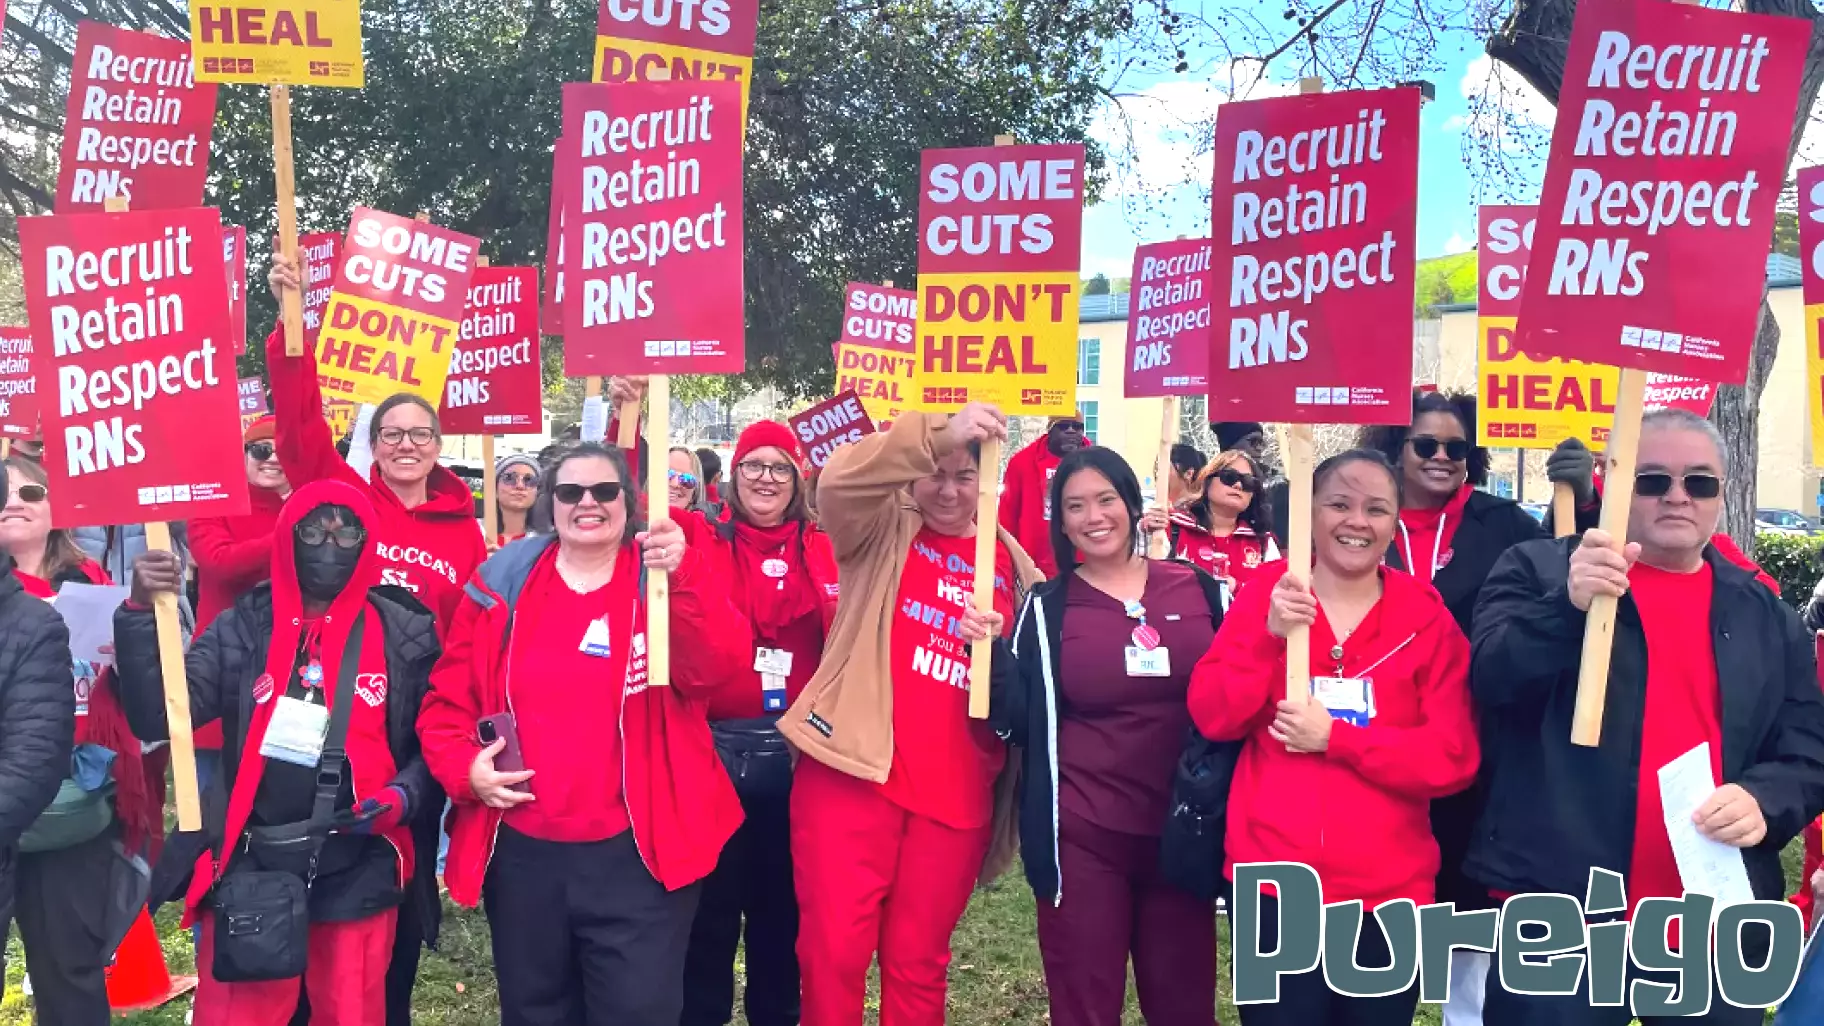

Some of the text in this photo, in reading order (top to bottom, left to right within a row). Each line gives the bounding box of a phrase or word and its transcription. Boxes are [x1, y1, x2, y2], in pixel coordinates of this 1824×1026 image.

[199, 7, 333, 48] HEAL
[608, 0, 731, 36] CUTS
[87, 44, 194, 89] Recruit
[1588, 30, 1770, 92] Recruit
[82, 85, 182, 125] Retain
[580, 95, 714, 158] Recruit
[76, 127, 198, 169] Respect
[1231, 107, 1386, 184] Recruit
[1573, 98, 1737, 156] Retain
[71, 168, 134, 203] RNs
[581, 150, 700, 214] Retain
[927, 159, 1075, 204] SOME
[1561, 168, 1759, 234] Respect
[1231, 173, 1367, 246] Retain
[303, 238, 335, 262] ecruit
[354, 218, 472, 273] SOME
[581, 201, 726, 270] Respect
[926, 213, 1054, 256] CUTS
[46, 226, 193, 297] Recruit
[309, 261, 332, 284] tain
[344, 254, 447, 303] CUTS
[1140, 246, 1212, 282] Recruit
[1229, 230, 1396, 307] Respect
[1547, 237, 1649, 297] RNs
[464, 276, 523, 309] ecruit
[582, 271, 655, 328] RNs
[924, 283, 1071, 323] DON'T
[1138, 276, 1202, 311] Retain
[51, 287, 184, 357] Retain
[330, 301, 451, 354] DON'T
[456, 307, 516, 342] etain
[846, 315, 913, 343] CUTS
[1135, 303, 1211, 342] Respect
[1228, 310, 1309, 370] RNs
[0, 334, 33, 354] ecrui
[0, 354, 29, 375] etain
[320, 337, 422, 387] HEAL
[448, 337, 531, 374] Respect
[842, 349, 917, 378] DON'T
[923, 334, 1047, 374] HEAL
[1133, 340, 1172, 372] RNs
[0, 375, 36, 398] espect
[58, 338, 219, 418] Respect
[447, 376, 491, 409] RNs
[839, 374, 904, 403] HEAL
[1487, 373, 1616, 413] HEAL
[796, 397, 864, 443] SOME
[64, 416, 146, 477] RNs
[376, 541, 457, 584] ROCCA'S
[911, 645, 973, 692] NUR
